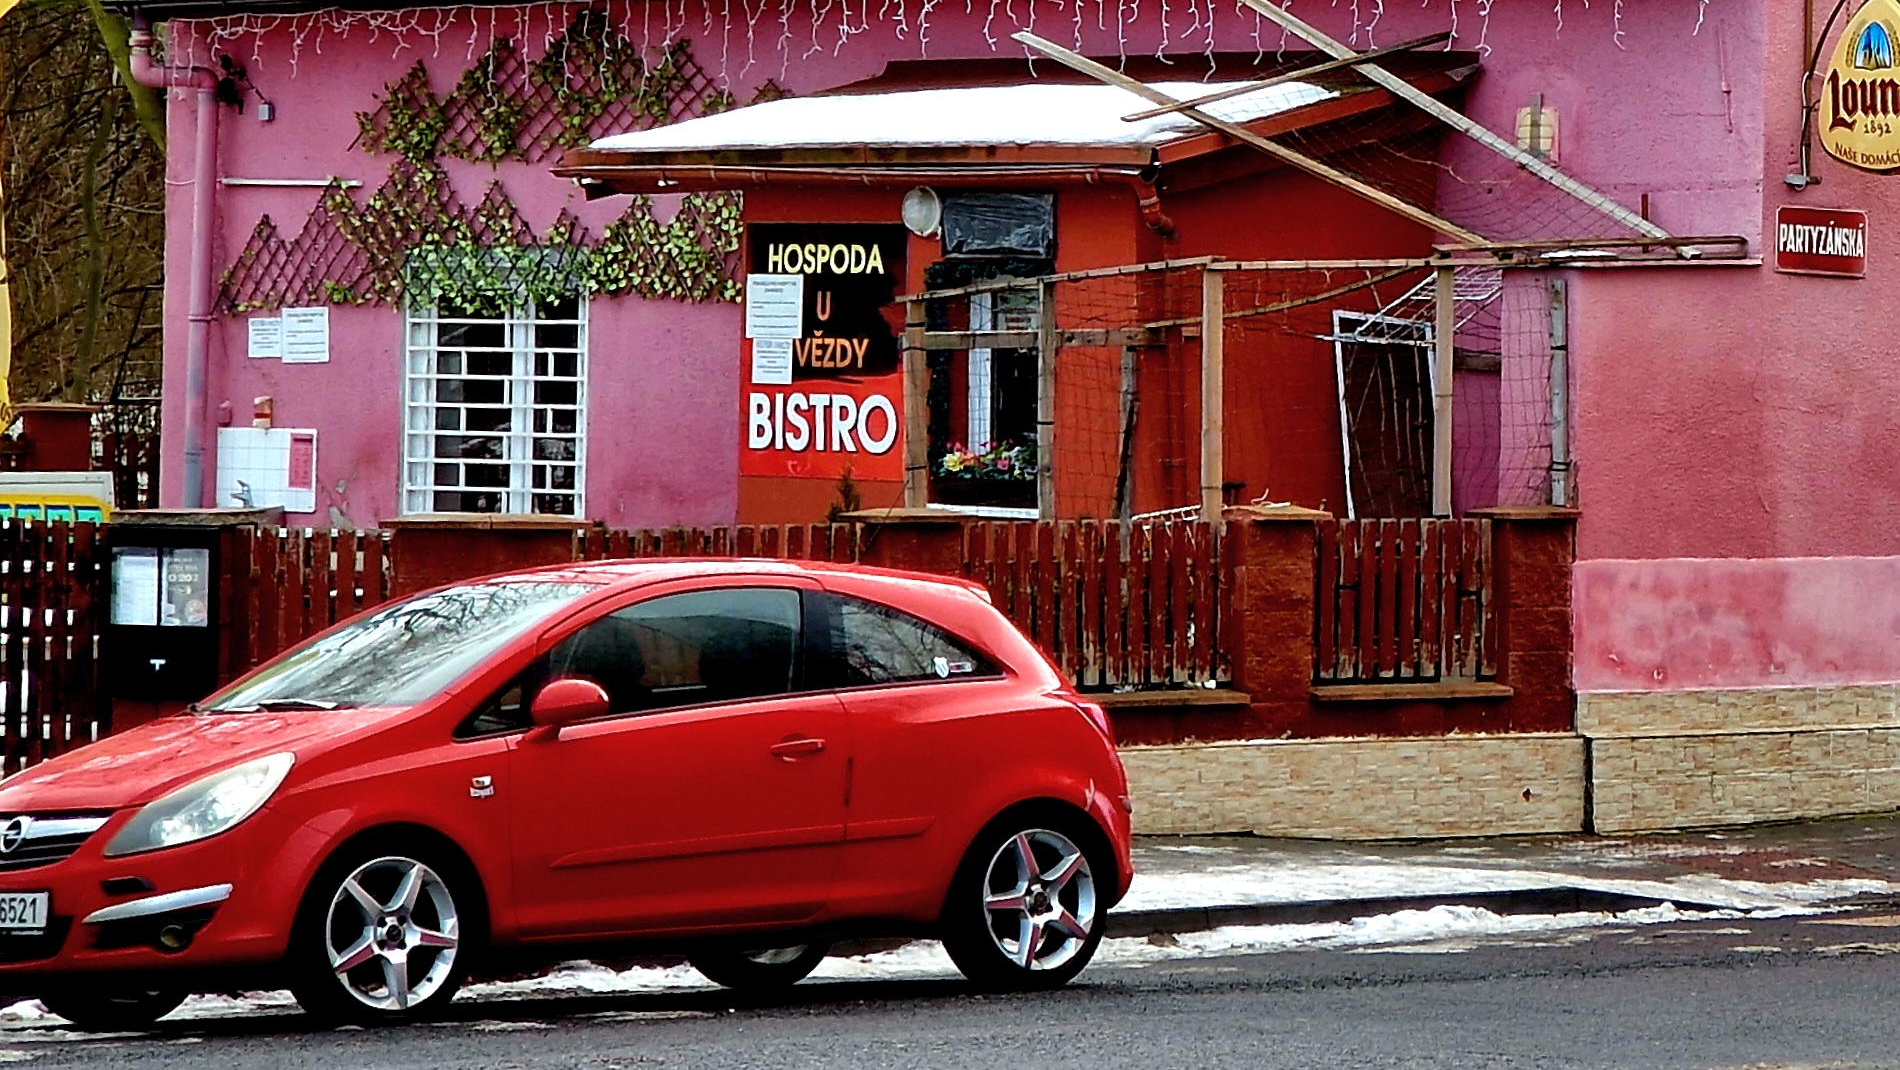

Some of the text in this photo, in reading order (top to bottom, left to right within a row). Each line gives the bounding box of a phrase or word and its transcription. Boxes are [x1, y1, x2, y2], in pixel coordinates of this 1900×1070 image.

[1863, 120, 1892, 137] 1892
[1834, 141, 1859, 163] NAŠE
[1779, 220, 1865, 258] PARTYZÁNSKÁ
[768, 243, 885, 275] HOSPODA
[816, 291, 831, 321] U
[795, 329, 870, 369] VĚZDY
[749, 392, 898, 454] BISTRO
[0, 897, 37, 924] 6521
